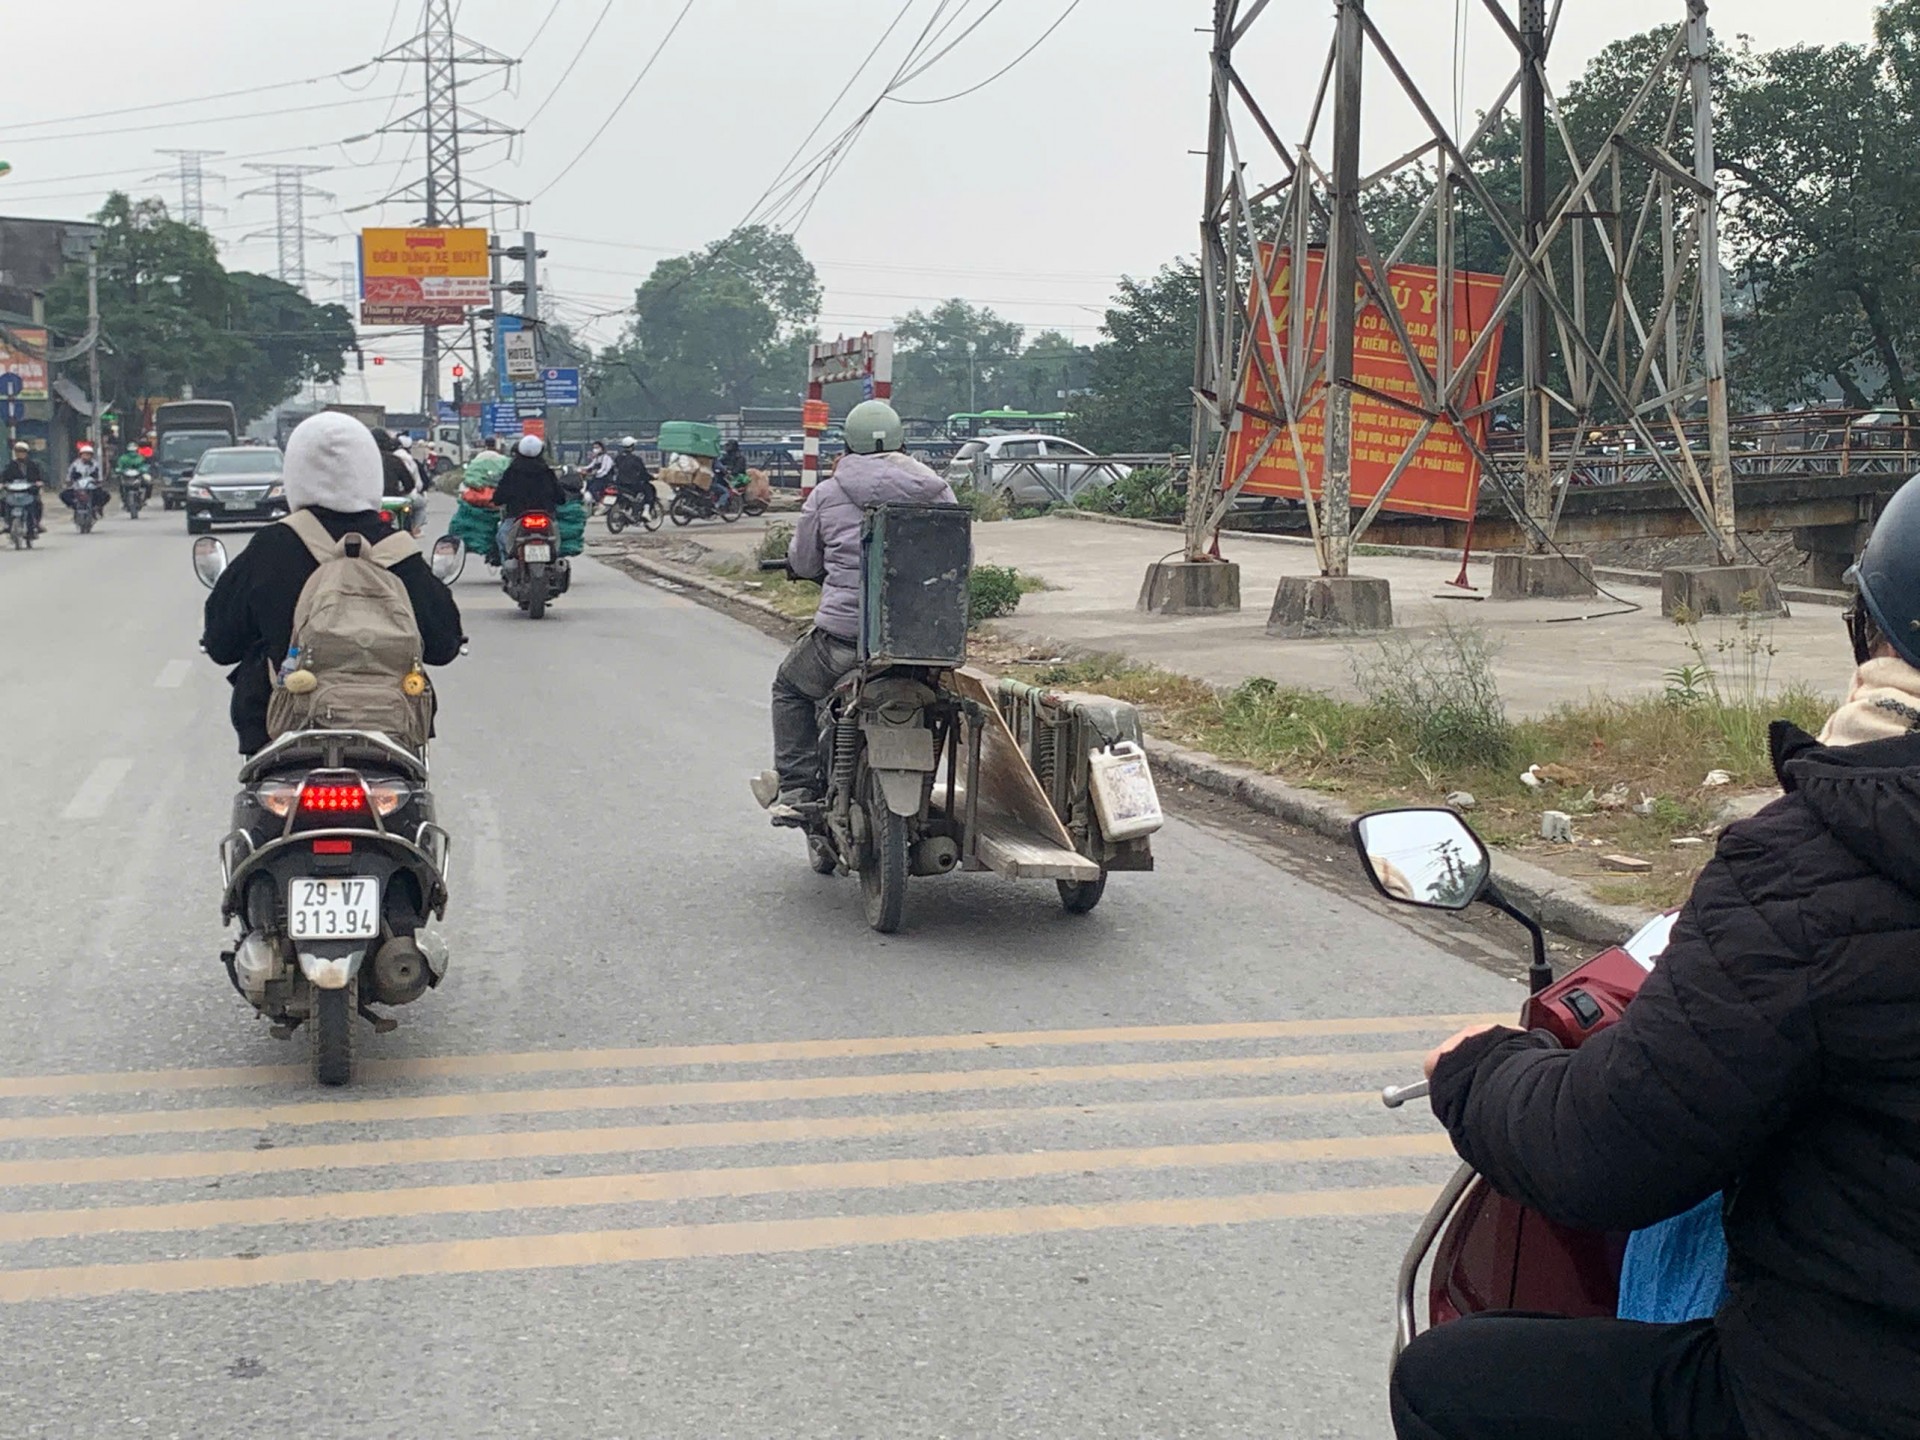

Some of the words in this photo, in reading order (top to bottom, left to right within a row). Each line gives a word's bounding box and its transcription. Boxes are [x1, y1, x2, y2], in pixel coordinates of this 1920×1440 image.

[435, 251, 448, 263] XE
[1407, 322, 1428, 337] CAO
[507, 348, 533, 360] HOTEL
[304, 882, 365, 907] 29-V7
[296, 909, 372, 934] 313.94
